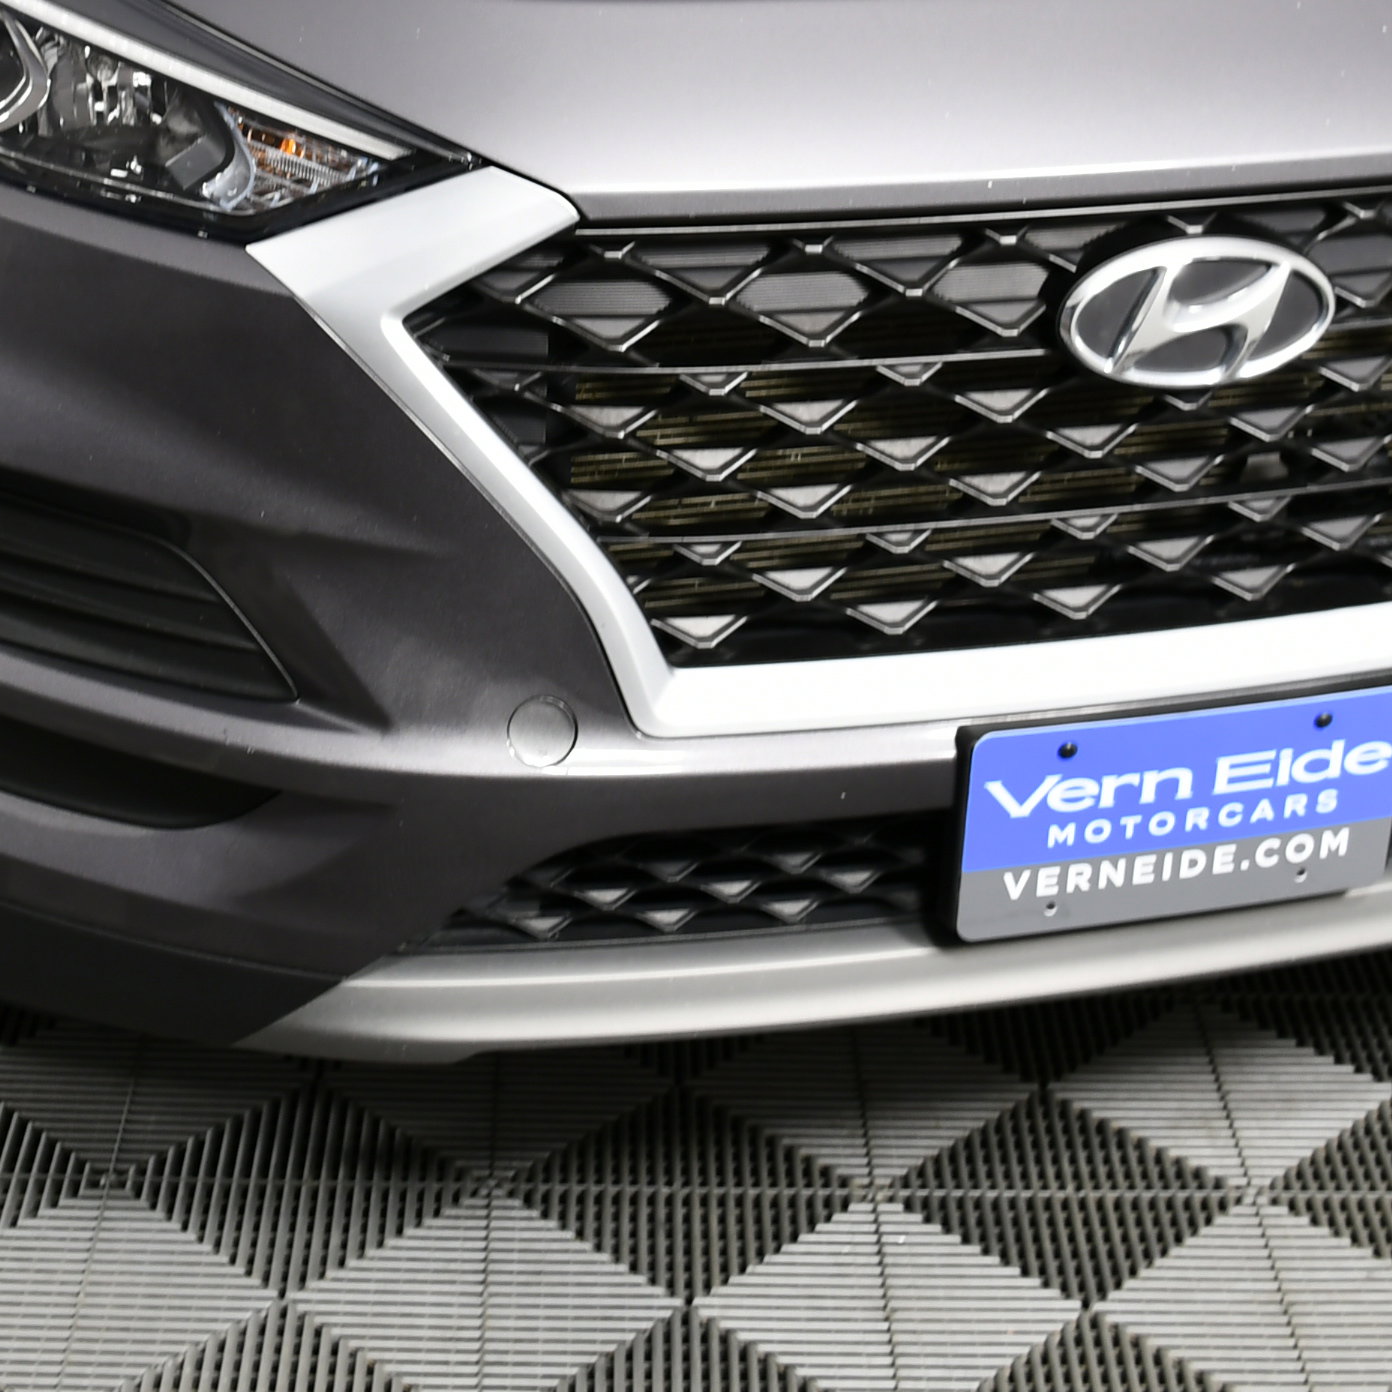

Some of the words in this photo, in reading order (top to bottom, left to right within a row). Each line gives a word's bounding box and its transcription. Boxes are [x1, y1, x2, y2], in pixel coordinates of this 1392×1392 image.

[983, 766, 1194, 819] Vern
[1046, 788, 1340, 850] MOTORCARS
[1003, 826, 1351, 901] VERNEIDE.COM
